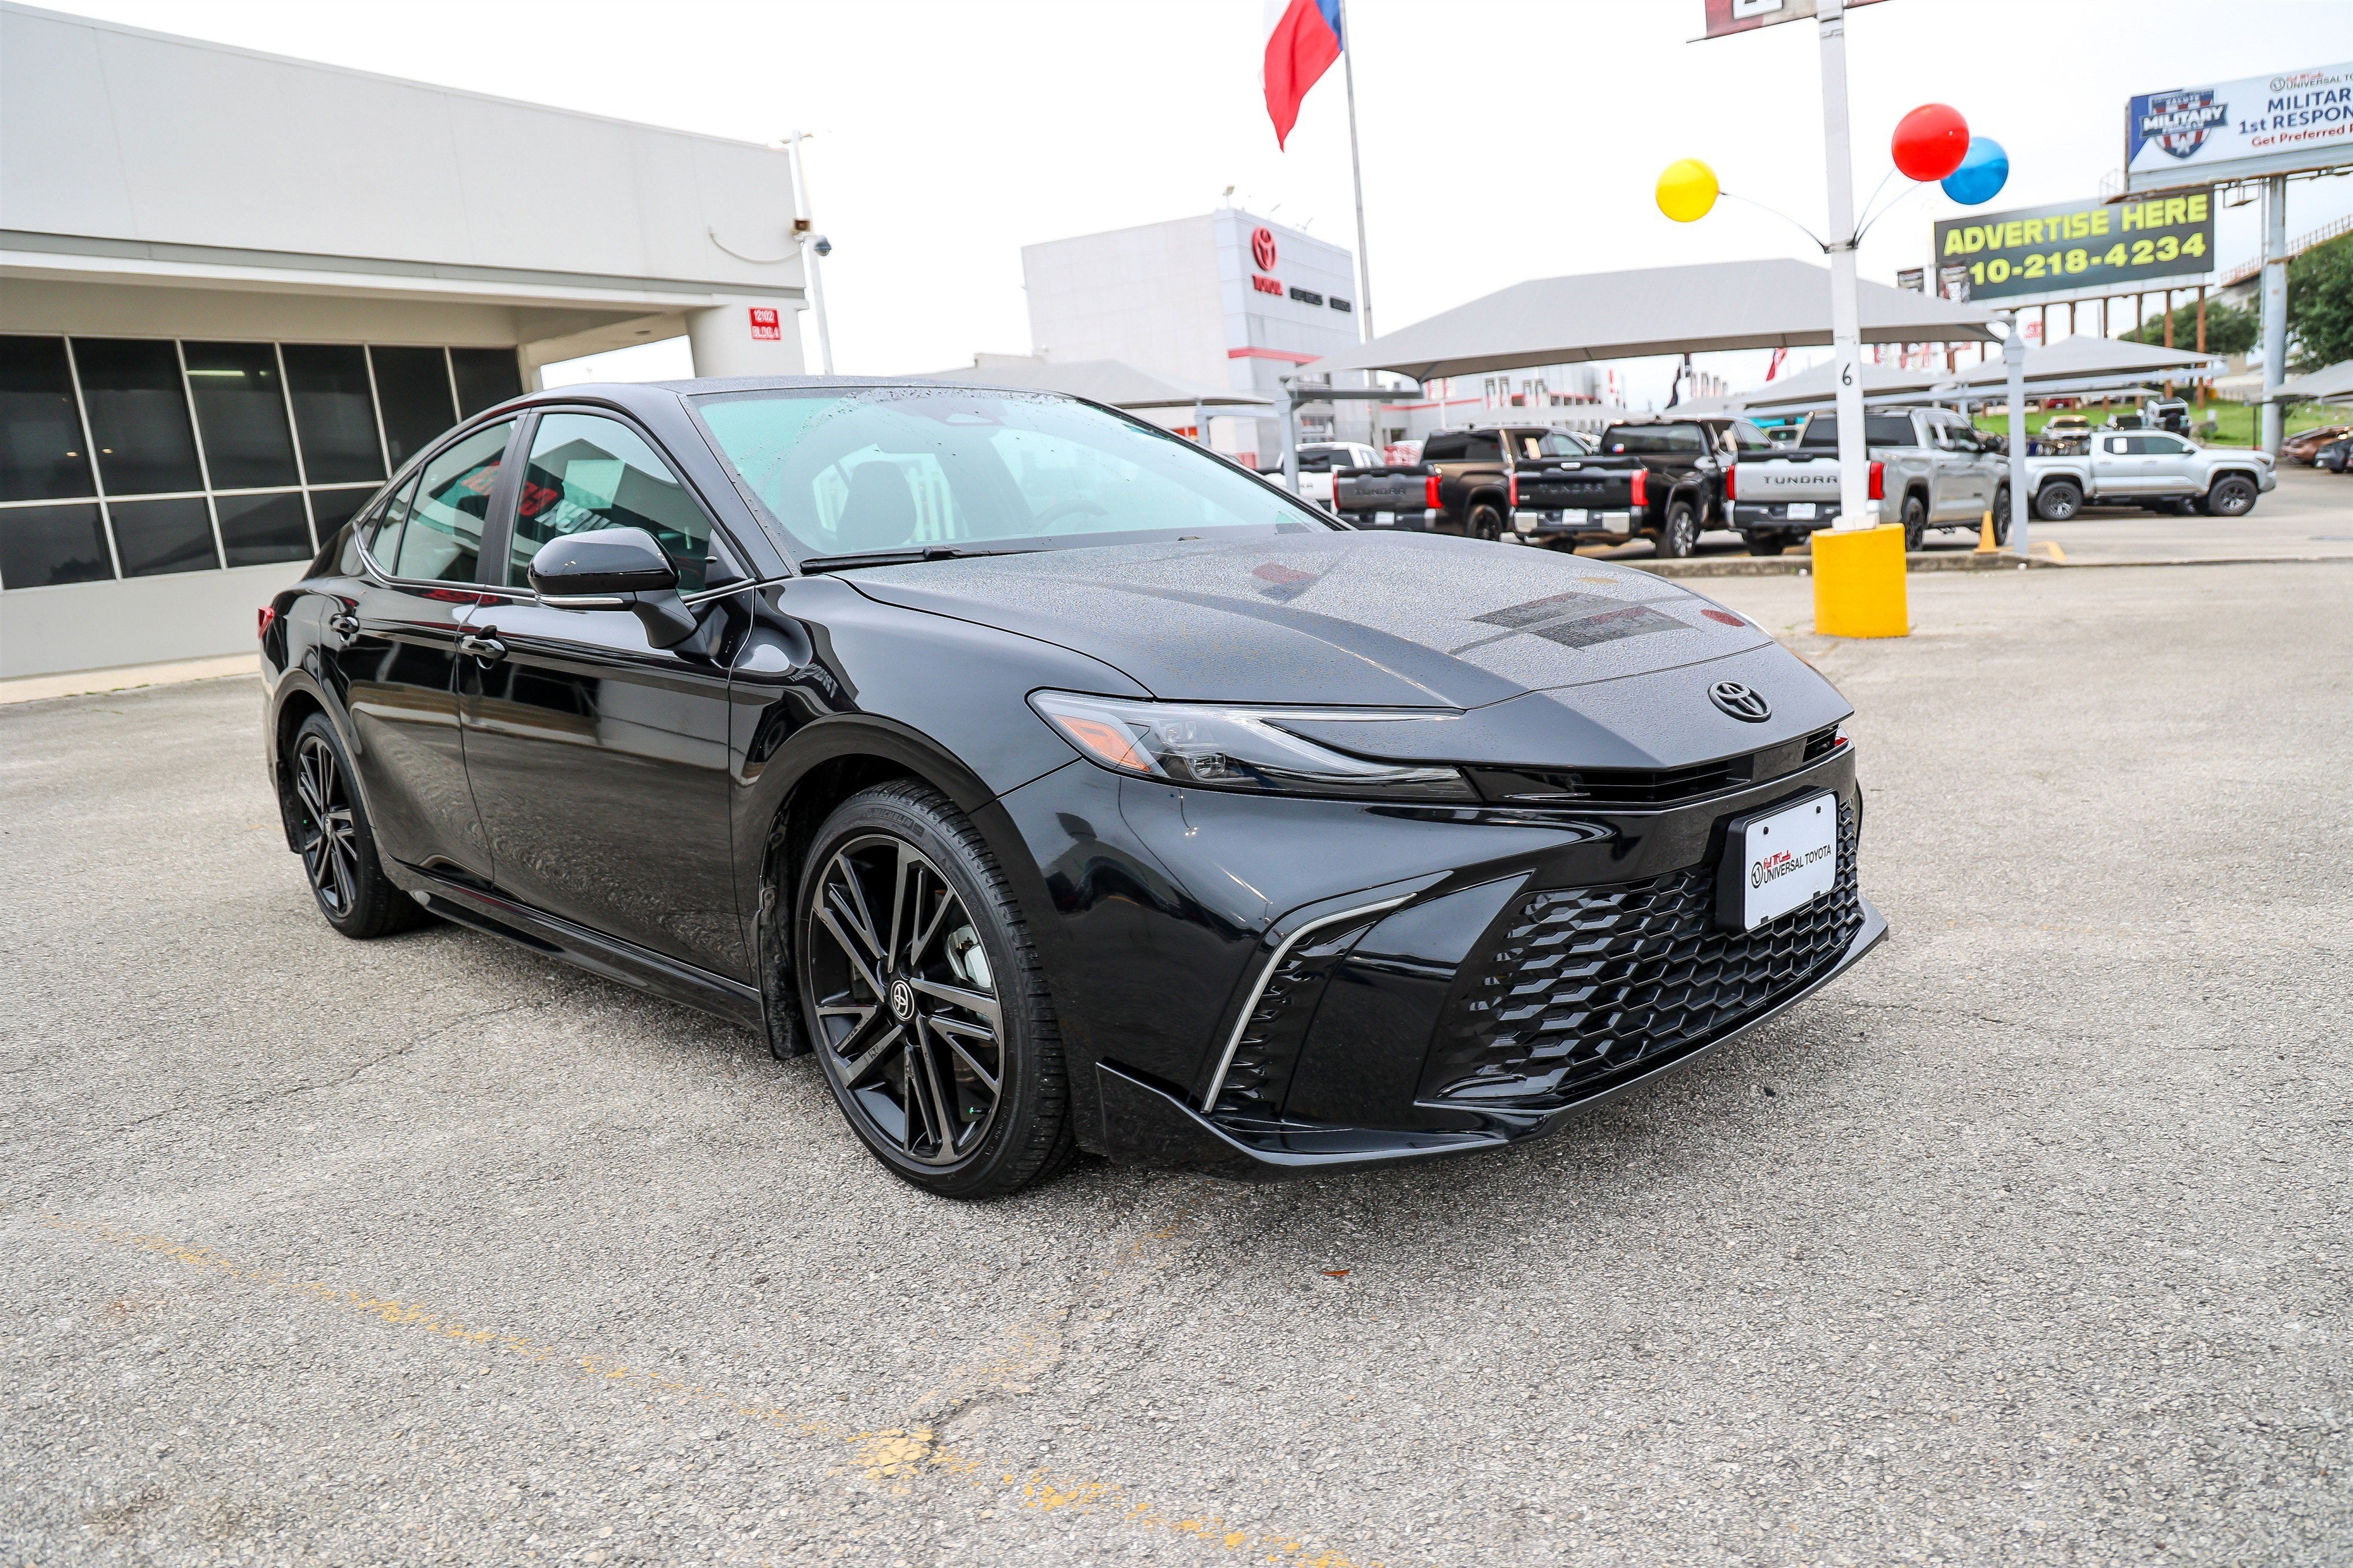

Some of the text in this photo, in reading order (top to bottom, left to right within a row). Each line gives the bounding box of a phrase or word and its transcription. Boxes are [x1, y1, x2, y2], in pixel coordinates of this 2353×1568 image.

[2286, 75, 2341, 89] UNIVERSAL
[2267, 87, 2353, 113] MILITAR
[2143, 105, 2224, 132] MILITARY
[2239, 118, 2266, 134] 1st
[2251, 136, 2275, 147] Get
[2279, 123, 2346, 142] Preferred
[1943, 194, 2208, 256] ADVERTISE HERE
[1969, 232, 2207, 285] 10-218-4234
[1842, 362, 1851, 385] 6
[1762, 476, 1838, 485] TUNDRA
[1764, 856, 1804, 883] UNIVERSAL
[1804, 844, 1831, 864] TOYOTA
